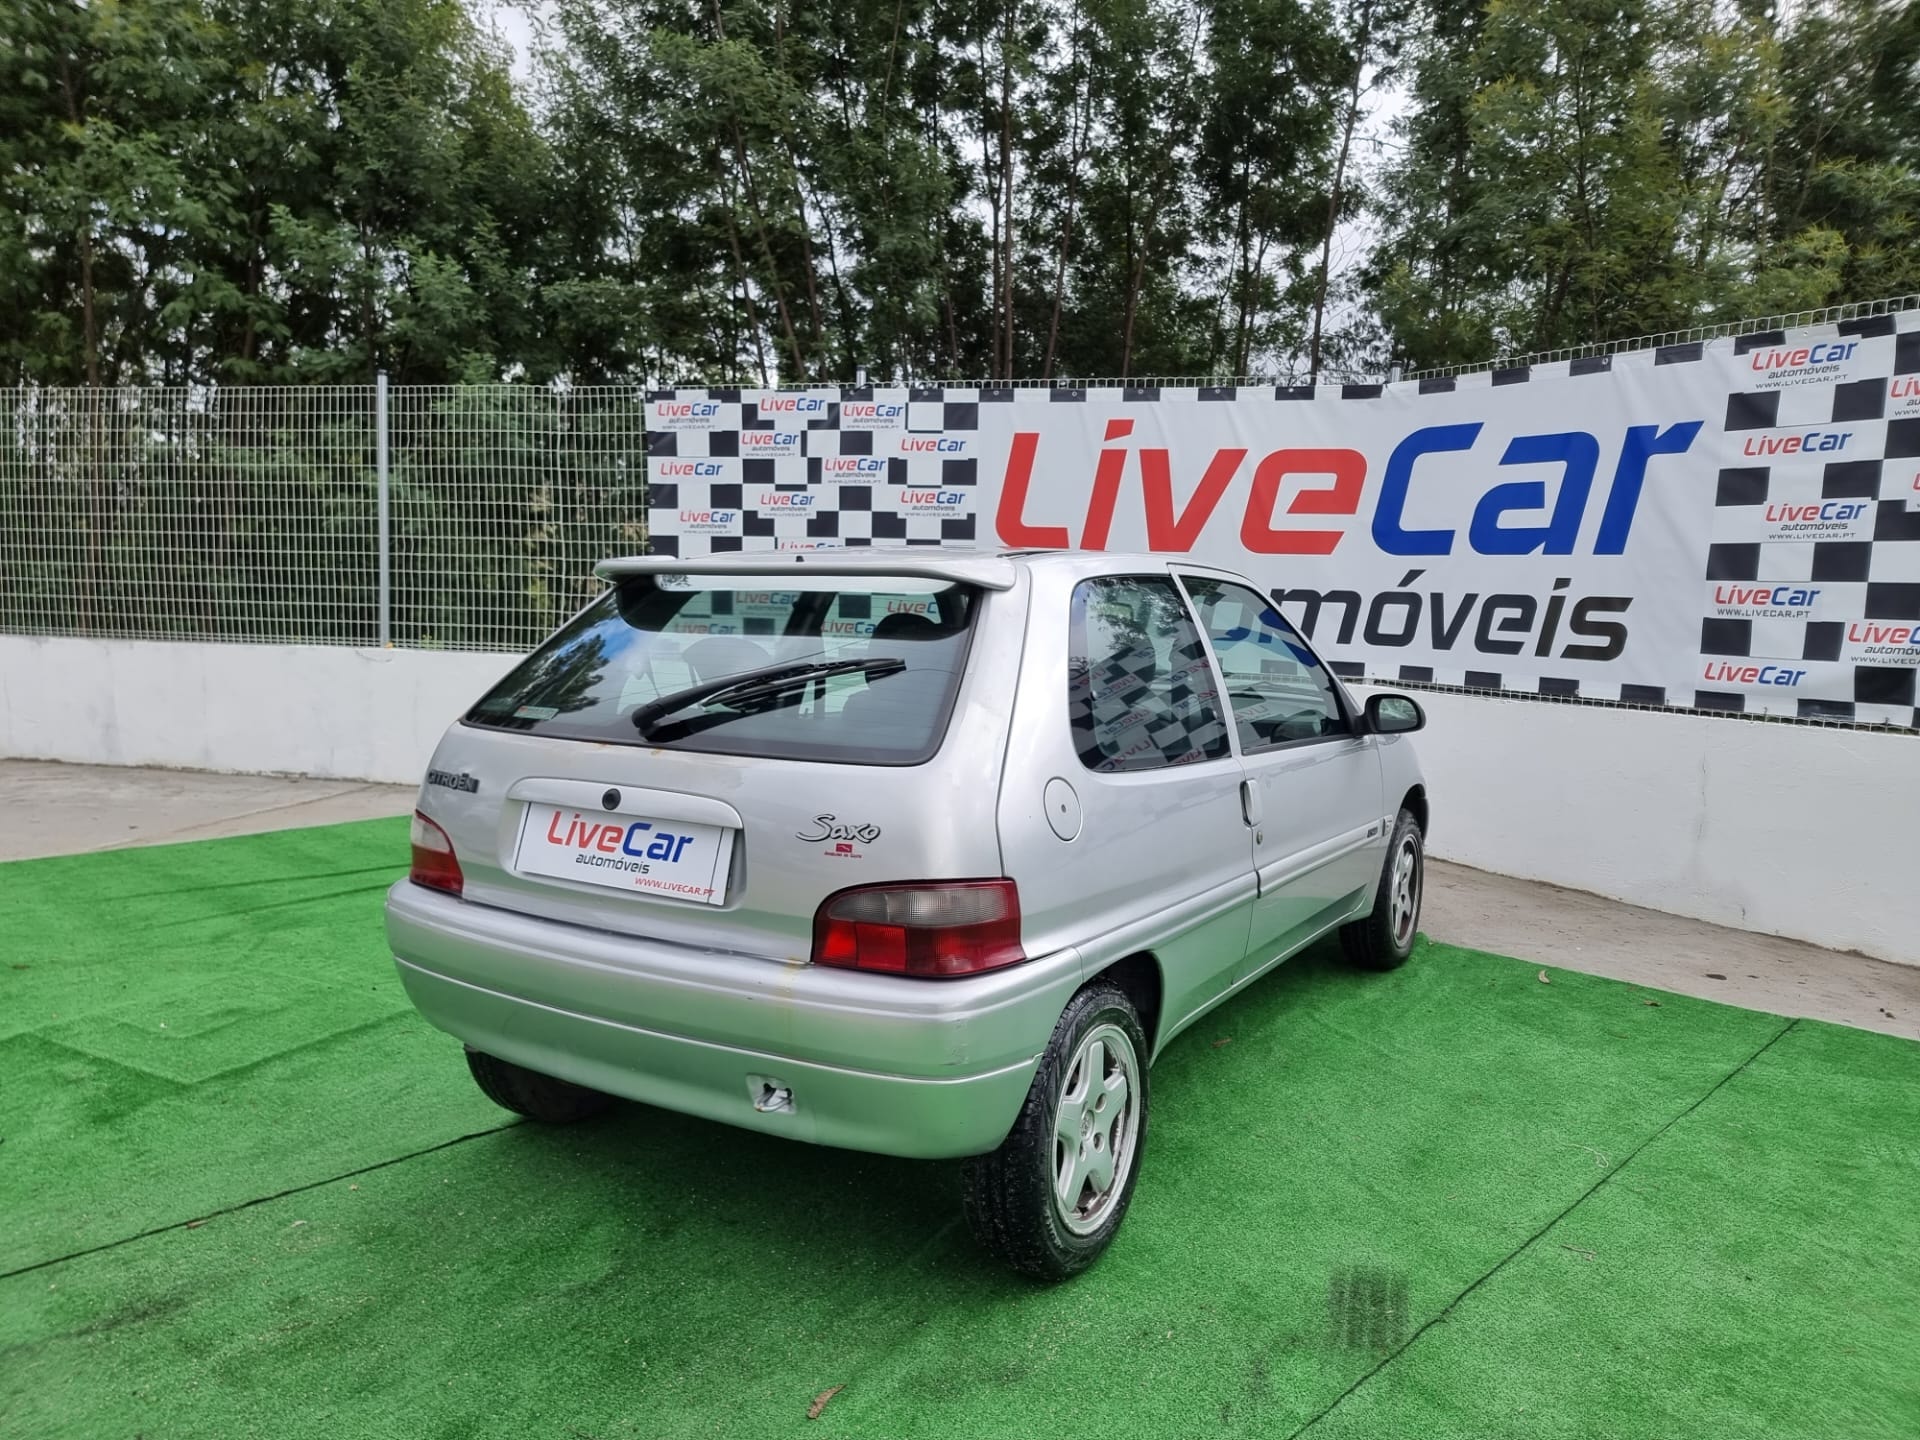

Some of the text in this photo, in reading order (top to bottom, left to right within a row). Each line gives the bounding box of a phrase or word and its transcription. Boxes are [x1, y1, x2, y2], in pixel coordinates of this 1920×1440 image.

[1752, 341, 1858, 371] LiveCar
[1768, 363, 1840, 380] automóveis
[1756, 374, 1848, 389] WWW.LIVECAR.PT
[658, 402, 719, 416] LiveCar
[760, 397, 825, 411] LiveCar
[843, 403, 904, 417] LiveCar
[742, 432, 799, 445] LiveCar
[901, 438, 966, 451] LiveCar
[1743, 432, 1853, 456] LiveCar
[660, 462, 723, 476] LiveCar
[824, 458, 886, 471] LiveCar
[995, 419, 1704, 555] LiveCar
[760, 493, 815, 506] LiveCar
[901, 490, 966, 504] LiveCar
[680, 510, 736, 523] LiveCar
[1765, 502, 1867, 522] LiveCar
[1780, 521, 1848, 531] automóveis
[1768, 532, 1855, 540] WWW.LIVECAR.PT
[1715, 585, 1821, 607] LiveCar
[886, 600, 938, 614] LiveC
[1717, 608, 1811, 619] WWW.LIVECAR.PT
[820, 620, 878, 634] LiveCa
[1704, 661, 1806, 686] LiveCar
[427, 768, 479, 794] CITROËN
[795, 813, 881, 844] Saxo
[547, 810, 694, 863] LiveCar
[575, 851, 650, 874] automóveis
[634, 877, 715, 897] WWW.LIVECAR.PT
